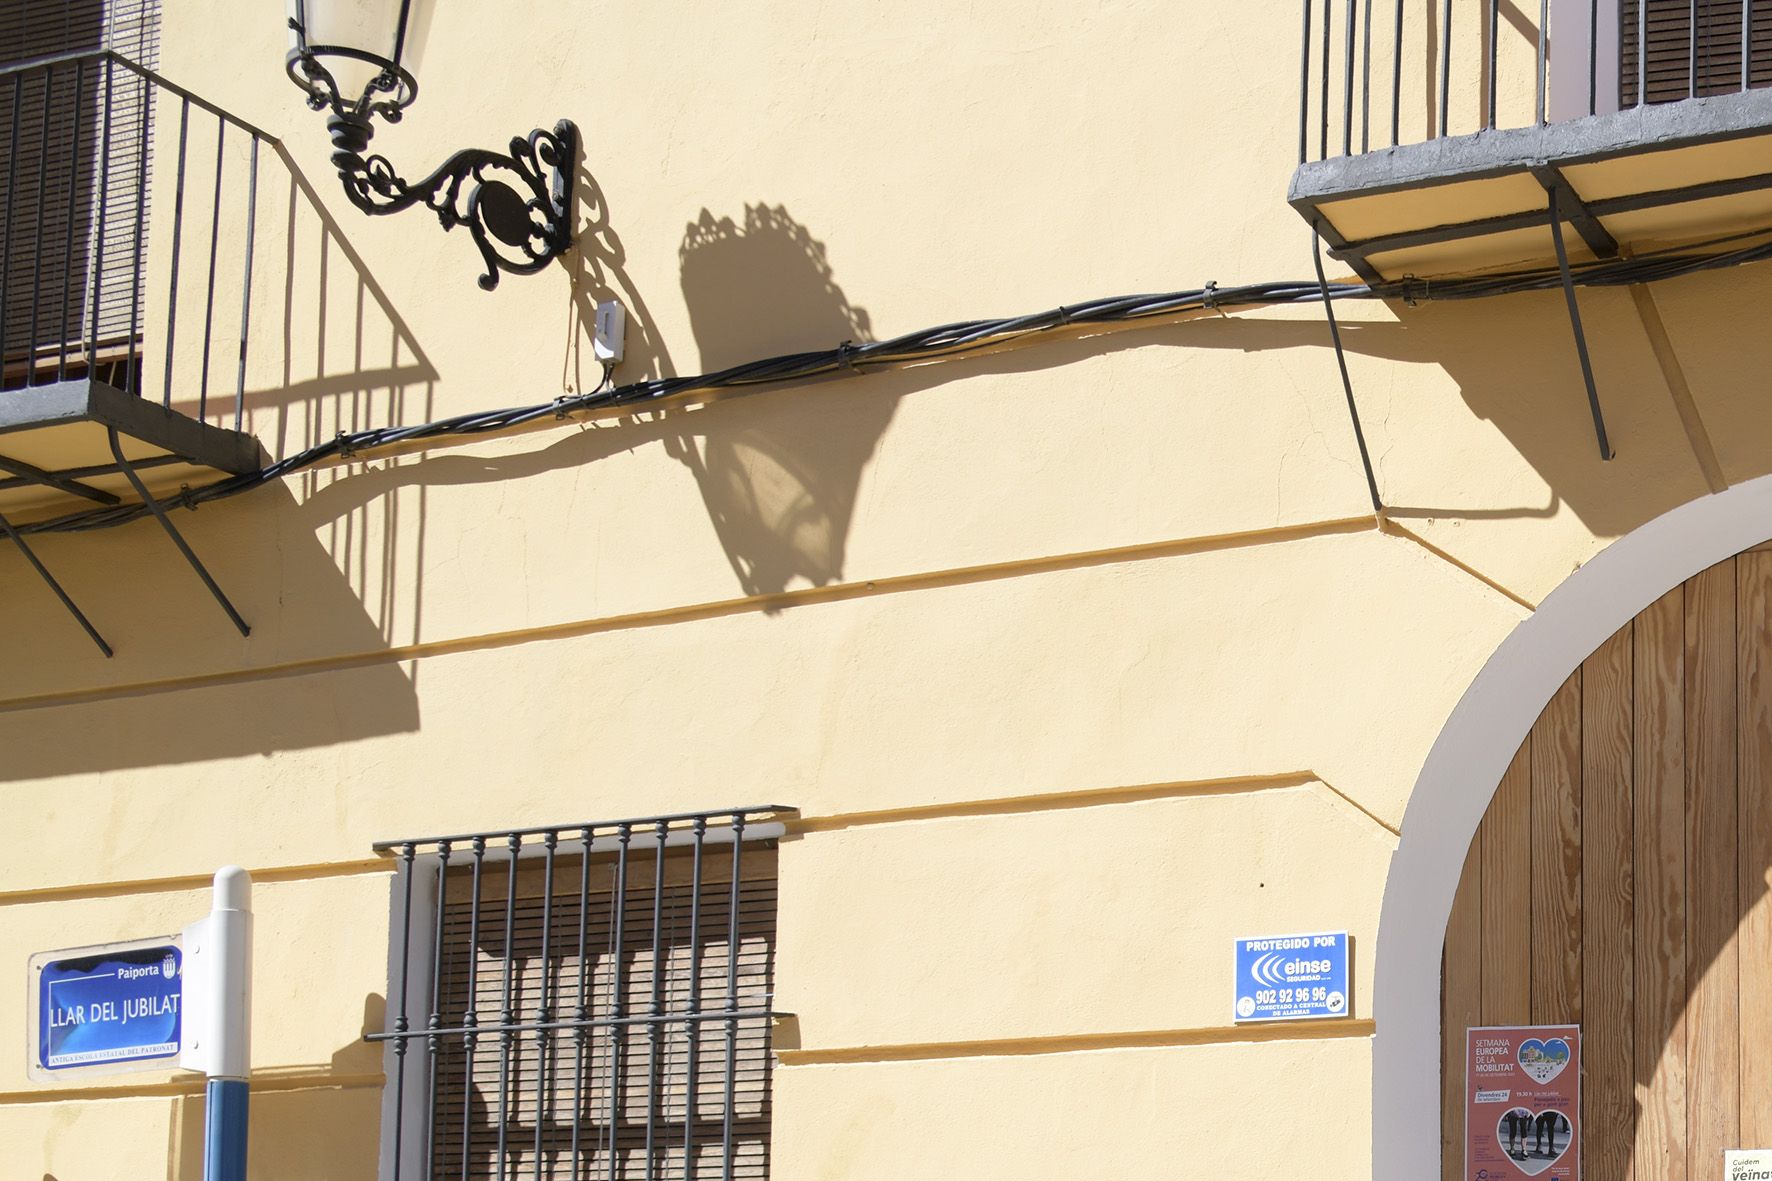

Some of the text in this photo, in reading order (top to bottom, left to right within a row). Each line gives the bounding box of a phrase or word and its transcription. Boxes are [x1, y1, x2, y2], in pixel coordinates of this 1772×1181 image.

[1246, 936, 1336, 952] PROTEGIDO POR
[118, 965, 159, 980] Paiporta
[1284, 957, 1332, 975] einse
[1286, 975, 1321, 983] SEGURIDAD
[1255, 987, 1327, 1005] 902 92 96 96
[50, 993, 181, 1028] LLAR DEL JUBILAT
[1475, 1039, 1511, 1047] SETMANA
[51, 1056, 74, 1065] ANTIGA
[127, 1048, 139, 1056] DEL
[141, 1044, 174, 1054] PATRONAT
[1475, 1047, 1509, 1055] EUROPEA
[1475, 1056, 1486, 1064] DE
[1475, 1064, 1514, 1072] MOBILITAT
